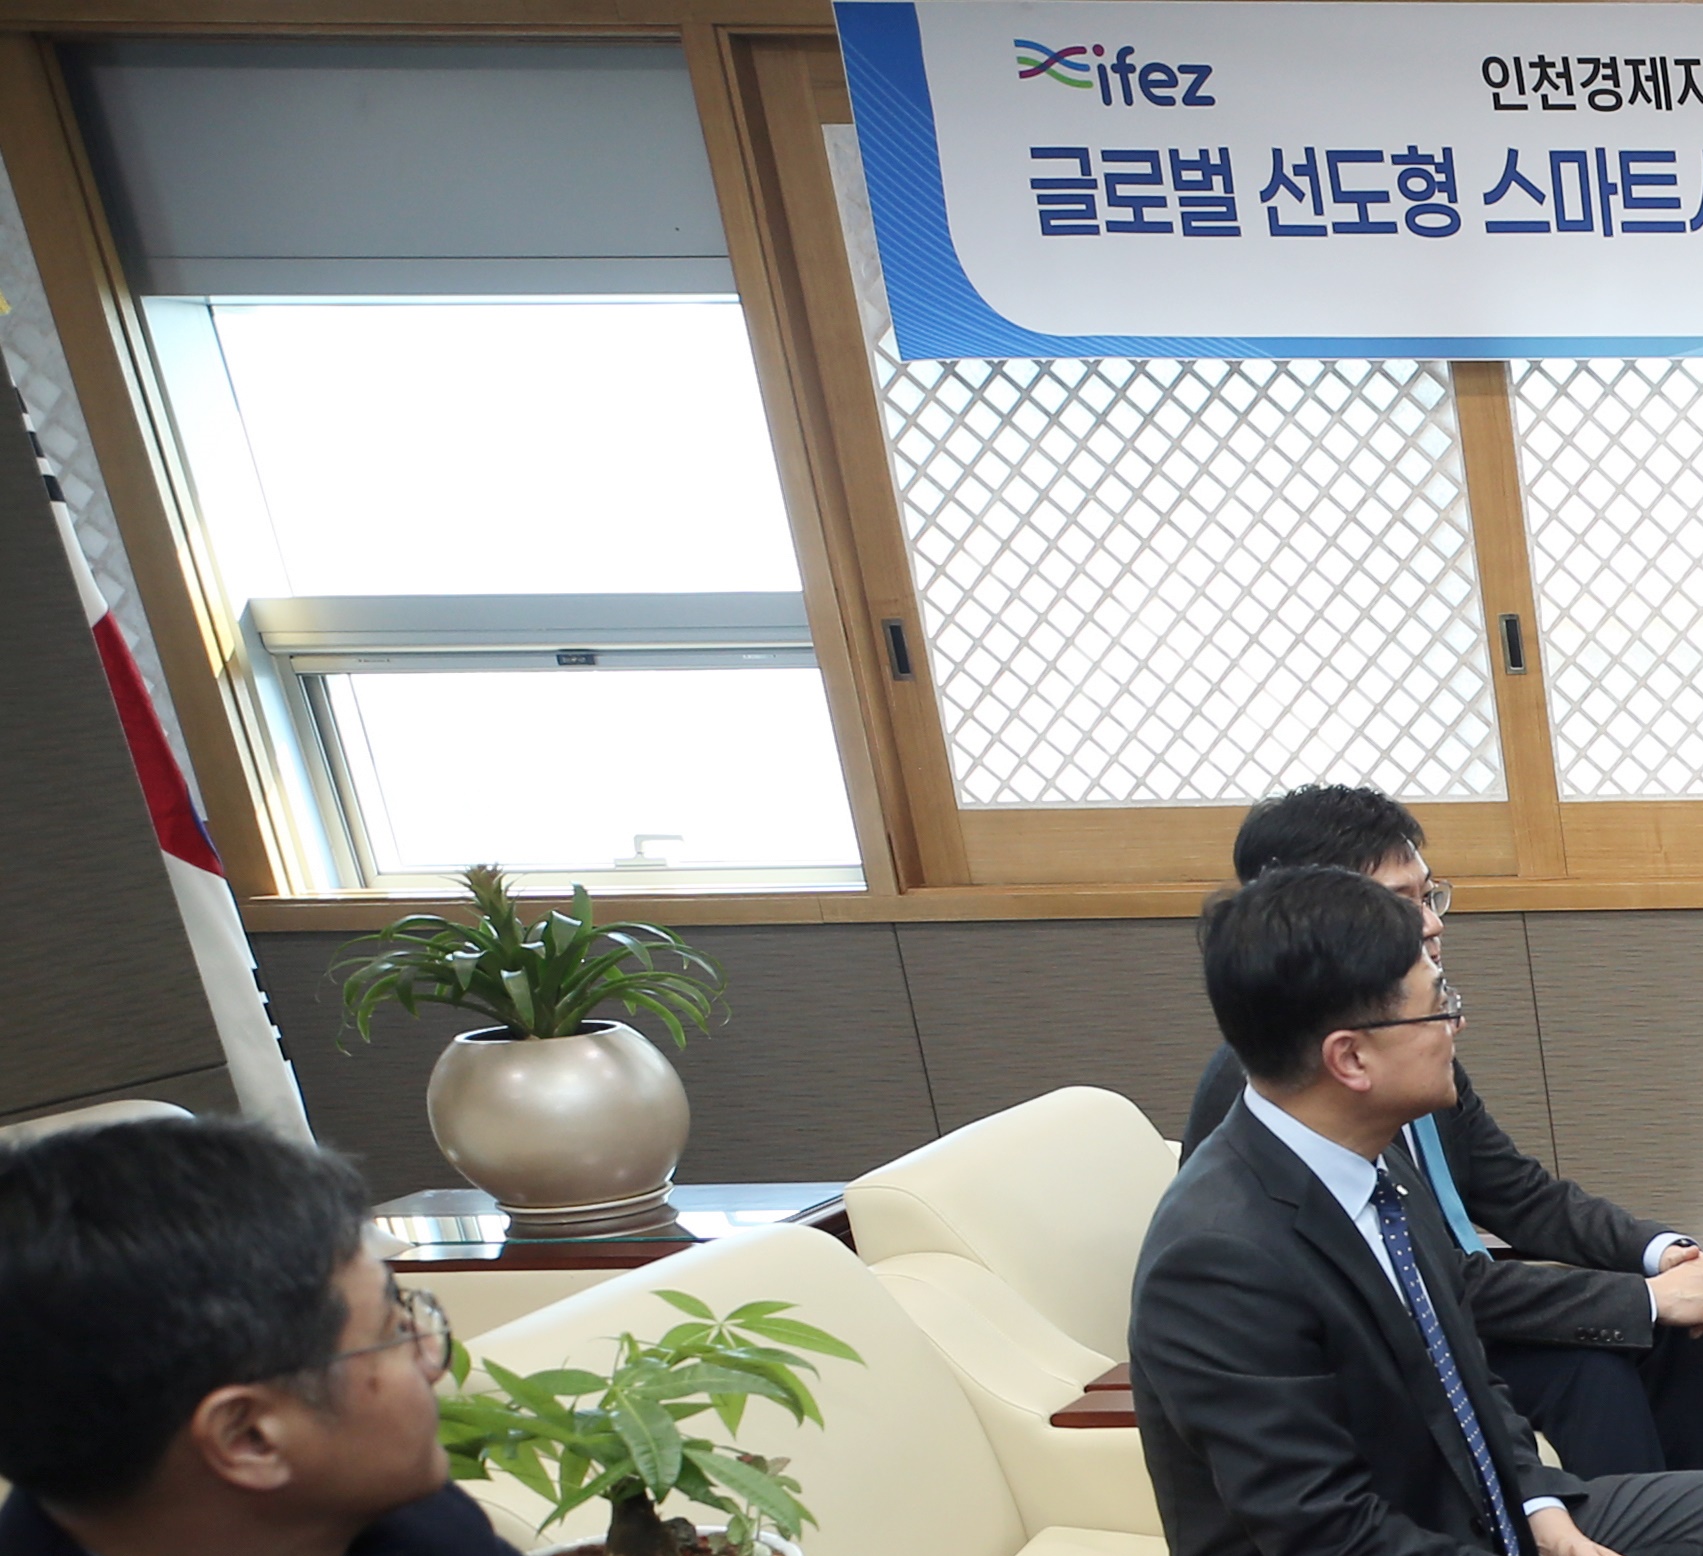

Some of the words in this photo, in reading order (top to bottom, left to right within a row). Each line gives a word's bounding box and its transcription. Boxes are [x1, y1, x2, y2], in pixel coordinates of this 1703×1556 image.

[1091, 43, 1217, 108] ifez
[1029, 146, 1243, 239] 글로벌
[1259, 144, 1464, 240] 선도형
